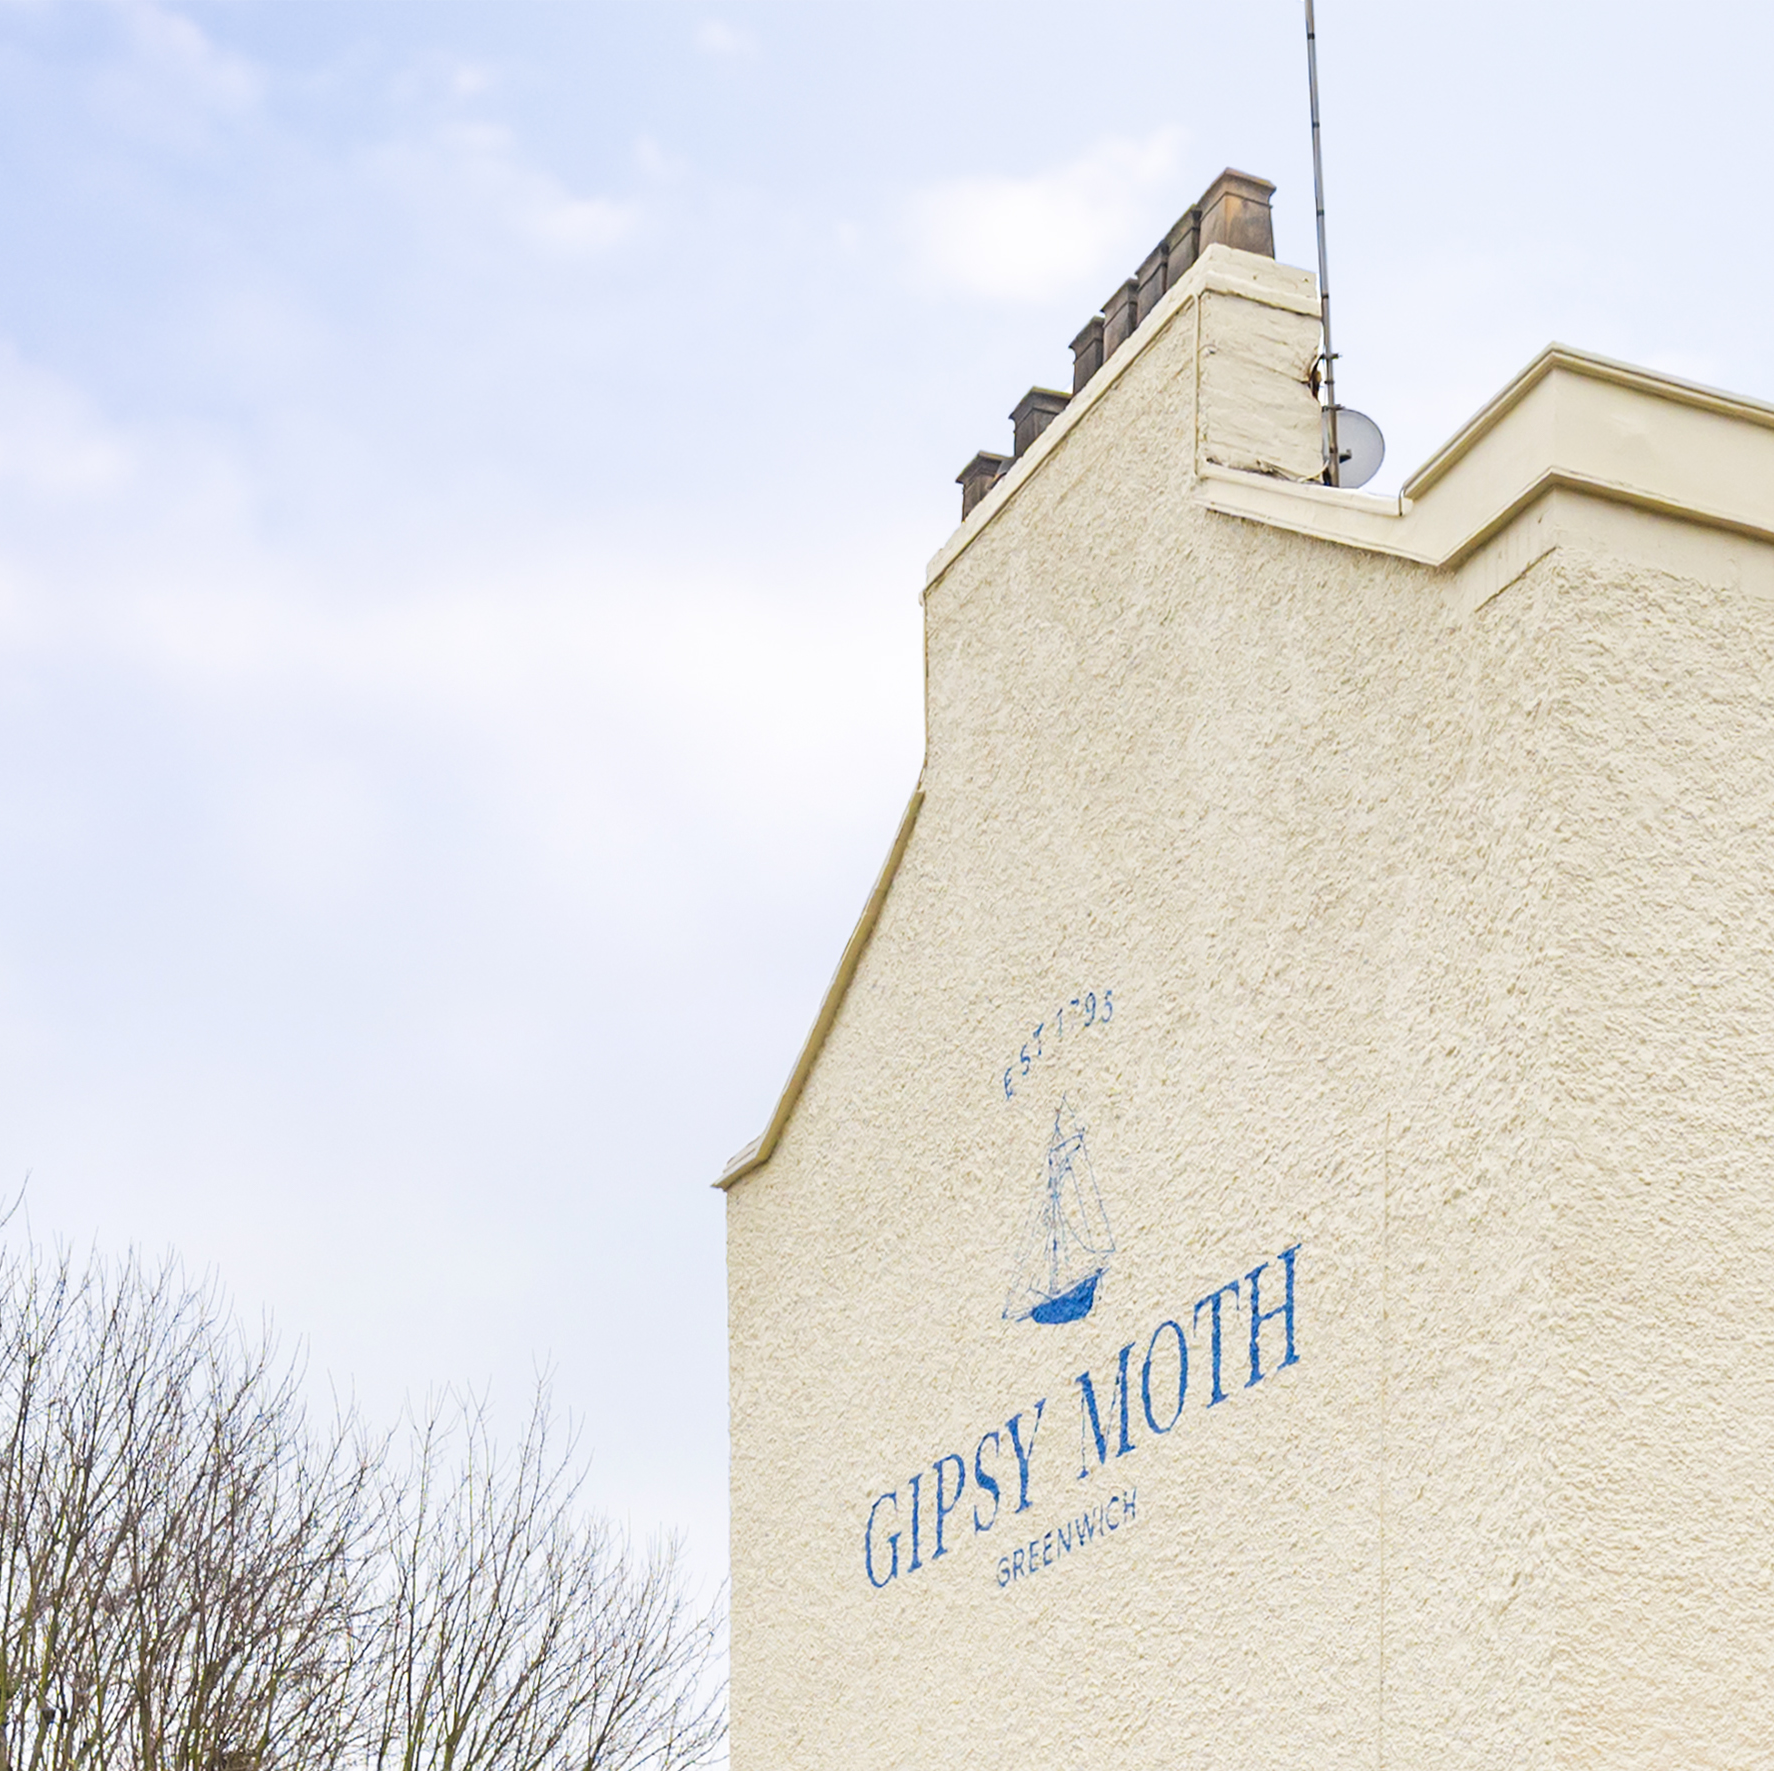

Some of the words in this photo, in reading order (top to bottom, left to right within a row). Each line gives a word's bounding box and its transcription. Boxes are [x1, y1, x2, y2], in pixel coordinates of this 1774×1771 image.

[864, 1398, 1046, 1589] GIPSY
[1075, 1243, 1302, 1480] MOTH
[996, 1488, 1137, 1588] GREENWICH
